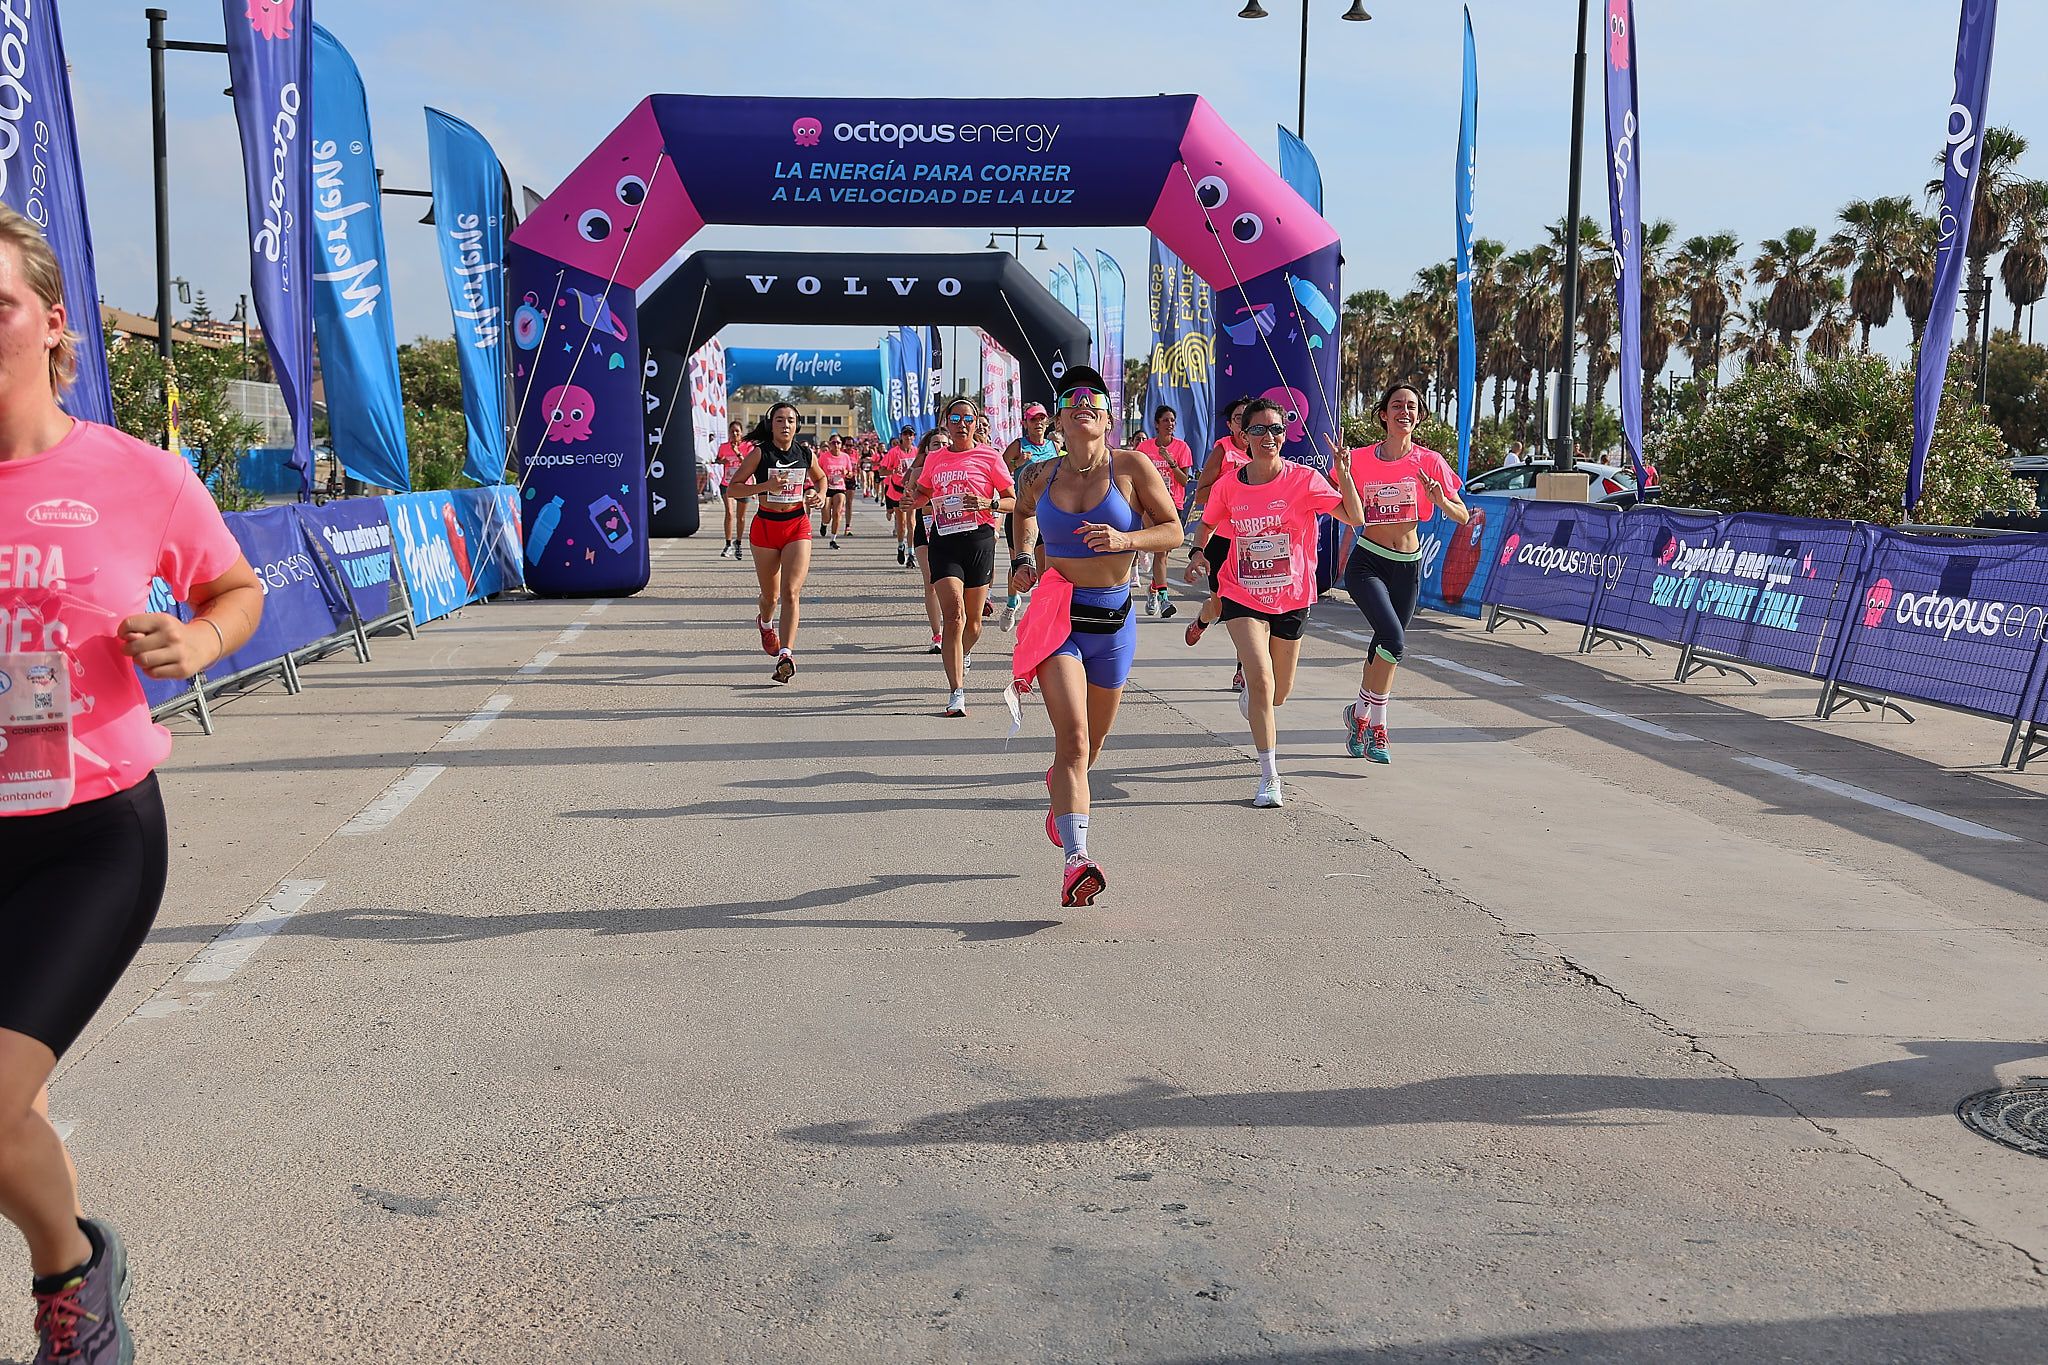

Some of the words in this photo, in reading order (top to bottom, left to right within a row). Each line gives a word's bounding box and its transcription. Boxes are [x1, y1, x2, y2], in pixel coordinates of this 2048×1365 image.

[834, 120, 955, 149] octopus
[959, 123, 1060, 153] energy
[774, 161, 803, 180] LA
[809, 159, 907, 182] ENERGÍA
[913, 164, 974, 182] PARA
[980, 164, 1071, 182] CORRER
[771, 186, 788, 202] A
[794, 187, 823, 203] LA
[829, 187, 958, 204] VELOCIDAD
[962, 188, 992, 204] DE
[996, 189, 1026, 204] LA
[1031, 189, 1075, 204] LUZ
[745, 274, 963, 297] VOLVO
[776, 352, 842, 381] Marlene
[644, 359, 668, 515] VOLVO
[524, 454, 575, 469] octopus
[575, 453, 624, 468] energy
[932, 470, 969, 485] CARRERA
[32, 508, 93, 522] ASTURIANA
[946, 511, 963, 519] 016
[1379, 504, 1400, 514] 016
[1234, 514, 1282, 533] CARRERA
[1251, 559, 1274, 569] 016
[1517, 541, 1580, 576] octopus
[1578, 549, 1628, 590] energy
[1733, 548, 1798, 591] energía
[1696, 579, 1760, 621] SPRINT
[1752, 589, 1805, 632] FINAL
[1896, 589, 2006, 642] octopus
[11, 725, 66, 736] CORREDORA
[7, 769, 53, 781] VALENCIA
